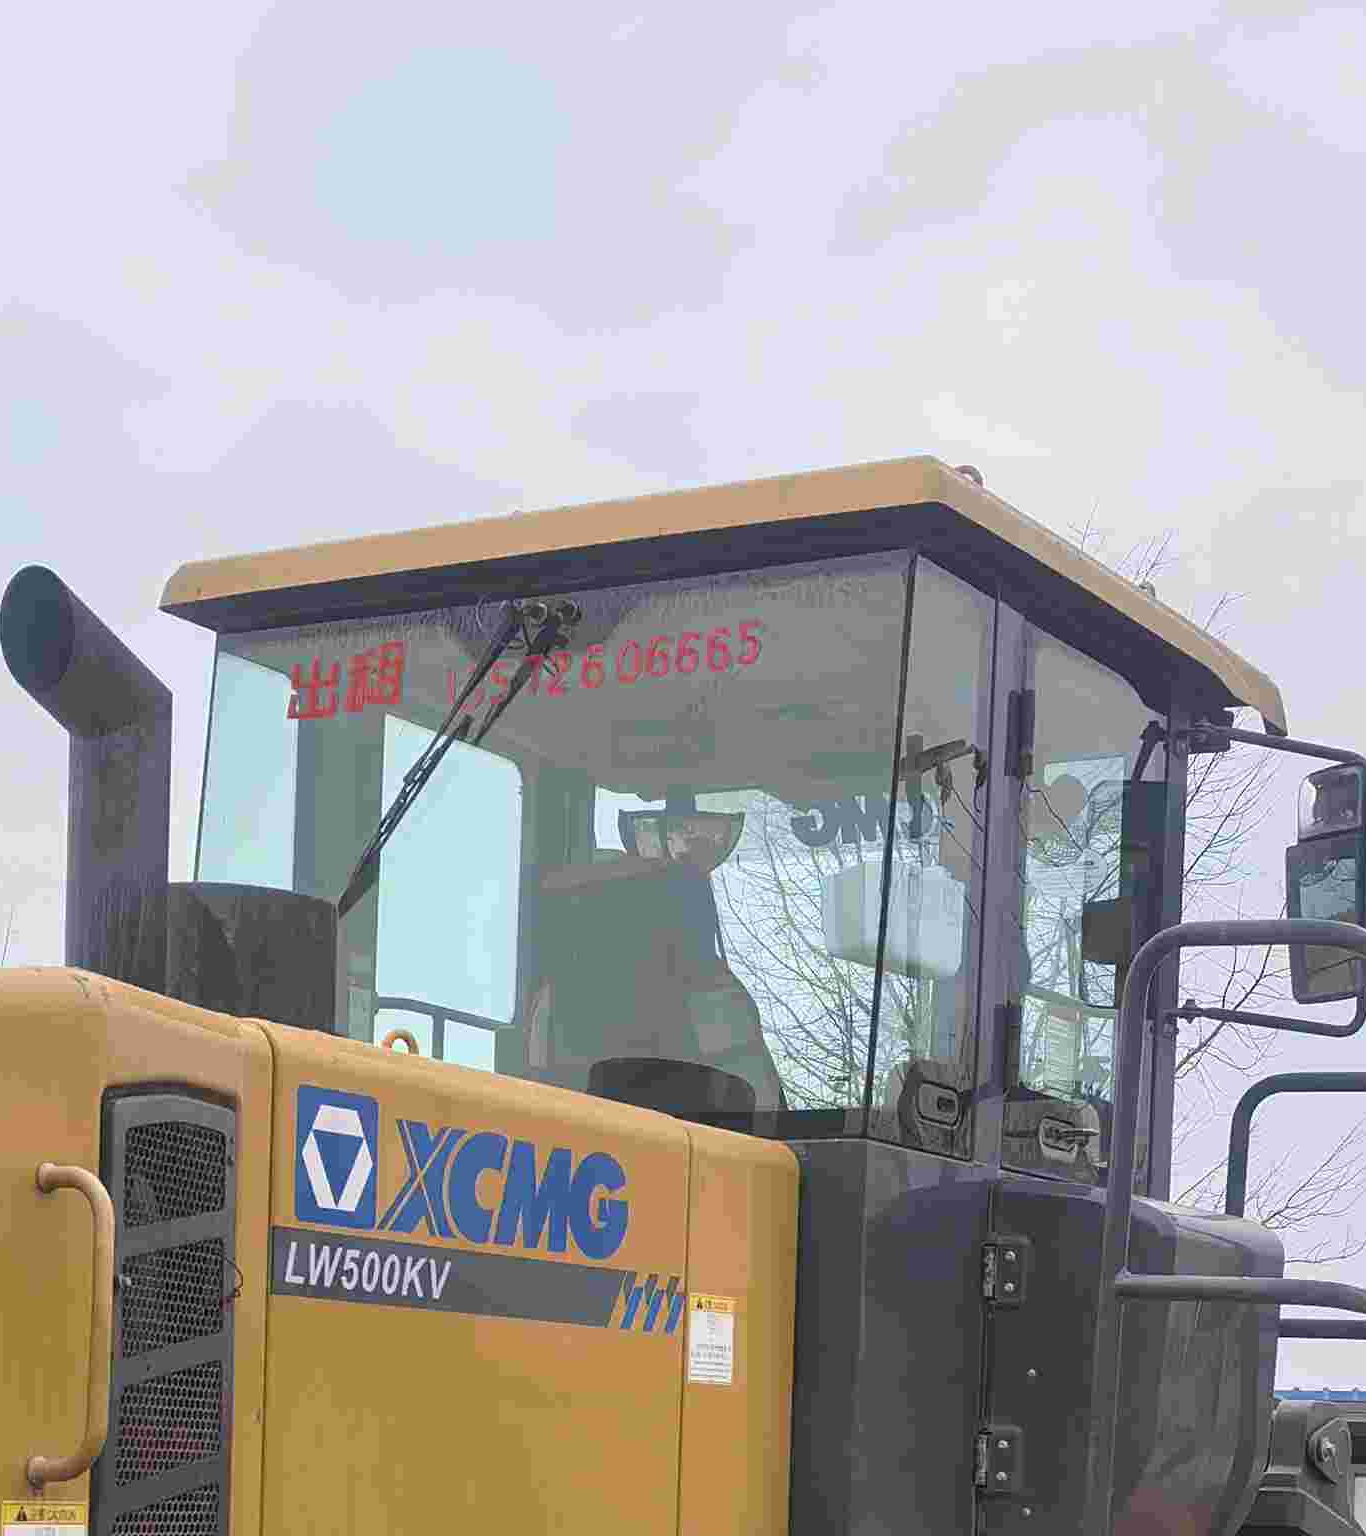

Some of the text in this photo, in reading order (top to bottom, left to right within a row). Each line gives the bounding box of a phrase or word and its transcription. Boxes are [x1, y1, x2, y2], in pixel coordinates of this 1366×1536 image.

[287, 641, 405, 720] 出租
[376, 1119, 629, 1260] XCMG
[284, 1241, 452, 1301] LW500KV
